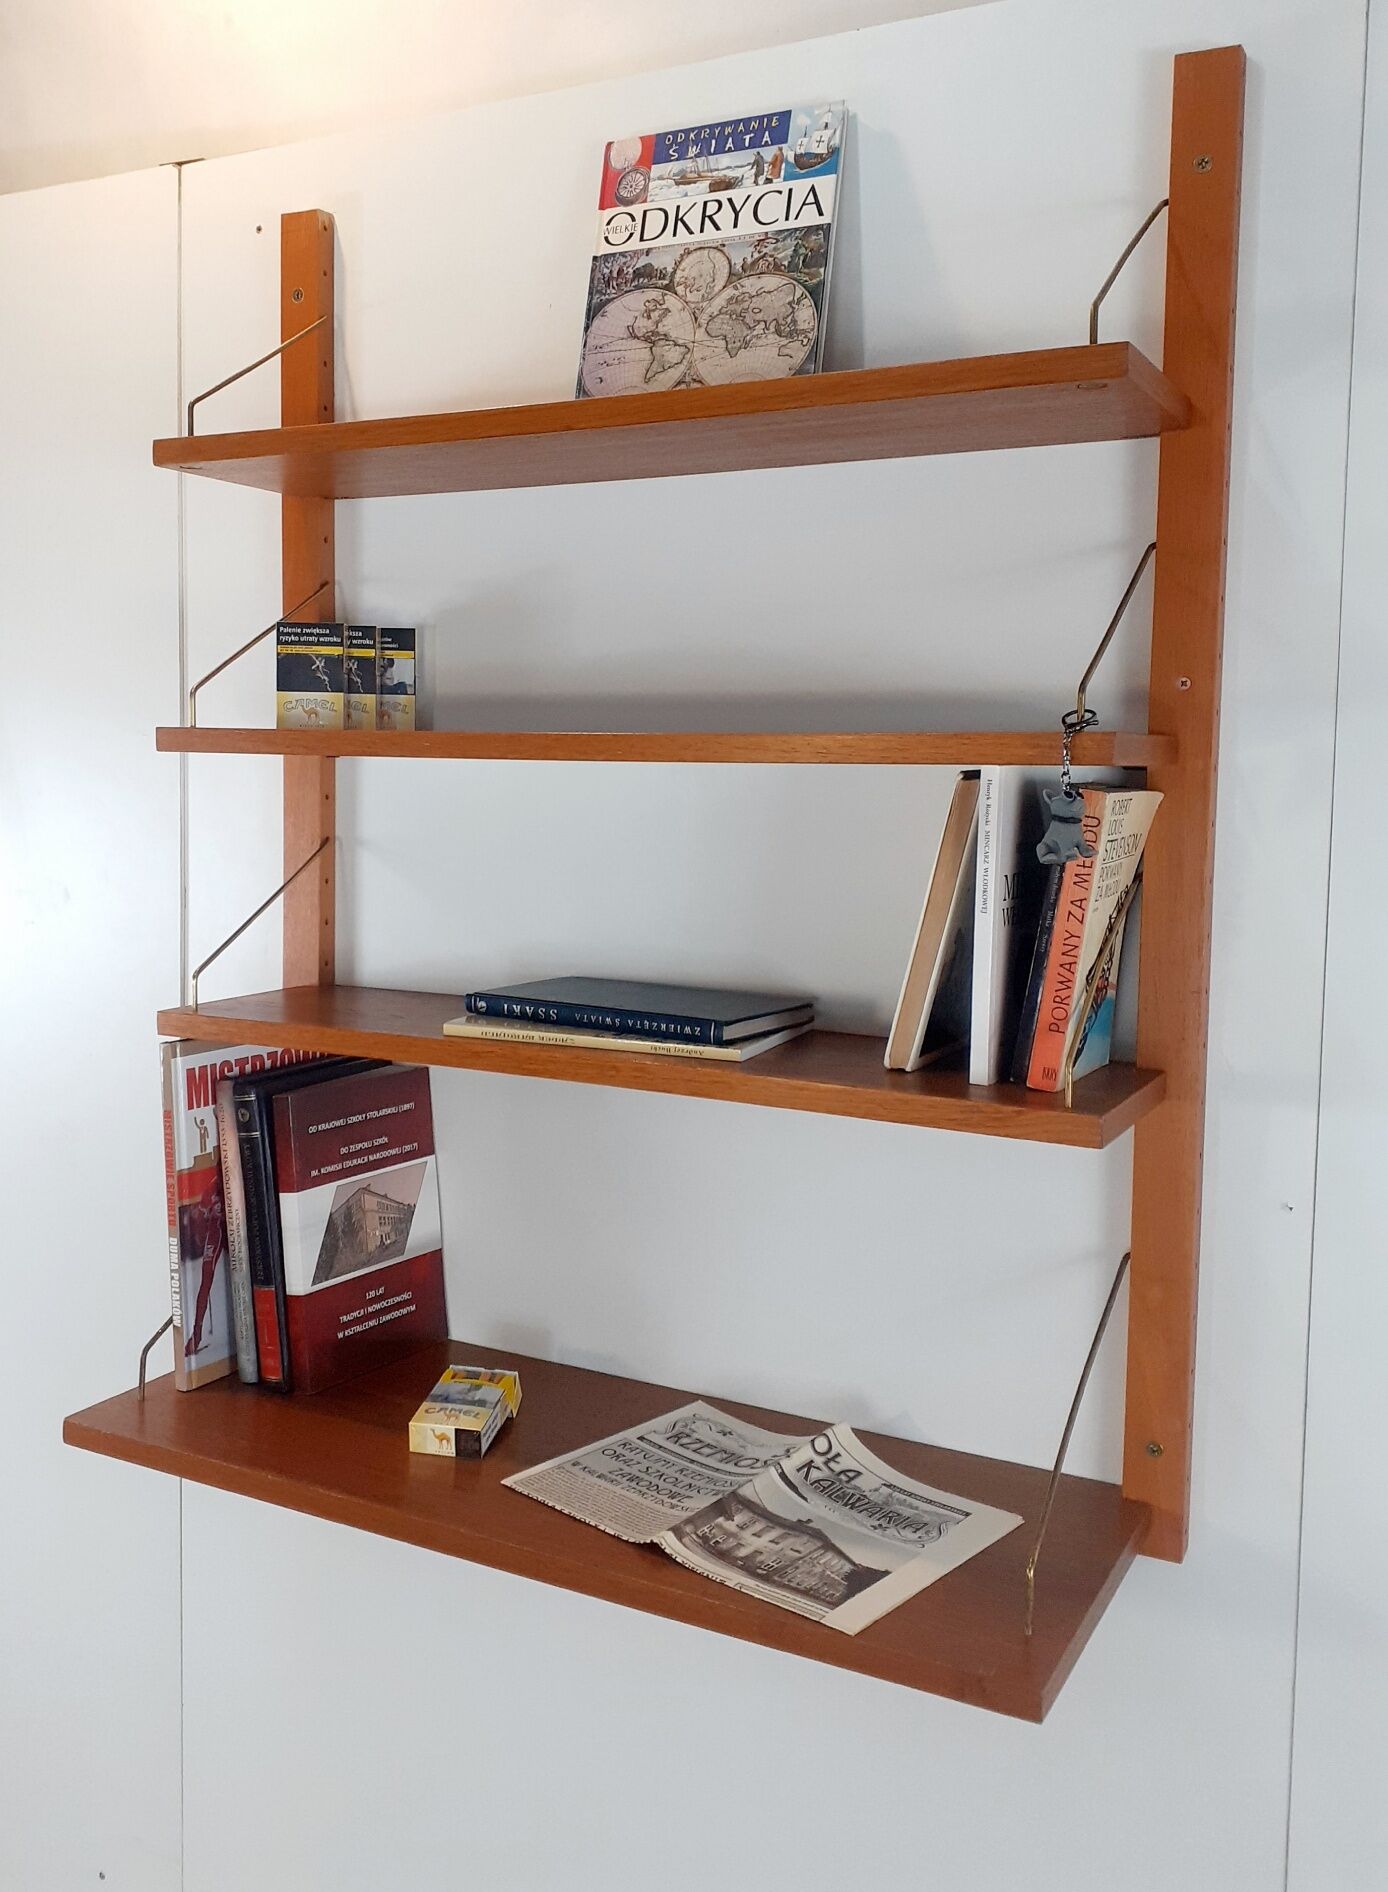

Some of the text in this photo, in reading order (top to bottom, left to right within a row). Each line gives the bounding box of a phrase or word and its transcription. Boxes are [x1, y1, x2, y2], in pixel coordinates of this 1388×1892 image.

[665, 116, 780, 145] ODKRYWANIE
[668, 131, 772, 160] ŚWIATA
[603, 223, 639, 235] WIELKIE
[604, 184, 825, 246] ODKRYCIA
[279, 634, 300, 643] ryzyko
[300, 635, 319, 643] utraty
[319, 635, 342, 643] wzroku
[302, 627, 330, 636] zwiększa
[351, 637, 374, 645] wzroku
[283, 698, 338, 713] CAMEL
[985, 779, 993, 800] Henryk
[983, 830, 991, 864] MINCARZ
[980, 867, 990, 914] WŁODKOWEJ
[1049, 931, 1083, 1034] PORWANY
[1067, 898, 1088, 925] ZA
[503, 1003, 701, 1036] ZWIERZĘTA ŚWIATA SSAKI
[308, 1125, 317, 1134] OD
[317, 1119, 347, 1132] KRAJOWEJ
[347, 1114, 366, 1124] SZKOŁY
[366, 1107, 398, 1120] STOLARSKIEJ
[320, 1163, 342, 1175] KOMISJI
[369, 1148, 402, 1163] NARODOWEJ
[402, 1142, 418, 1154] (2017)
[340, 1146, 348, 1155] DO
[169, 1236, 180, 1270] DUMA
[171, 1270, 183, 1328] POLAKÓW
[339, 1308, 365, 1324] TRADYCJI
[367, 1289, 413, 1314] NOWOCZESNOŚCI
[365, 1286, 385, 1300] 120 LAT
[337, 1304, 416, 1339] W KSZTAŁCENIU ZAWODOWYM
[424, 1407, 482, 1420] CAMEL
[601, 1448, 642, 1469] ORAZ
[638, 1465, 726, 1497] SZKOLNICTW
[608, 1467, 694, 1504] ZAWODOWE
[796, 1460, 930, 1535] KALWARIA
